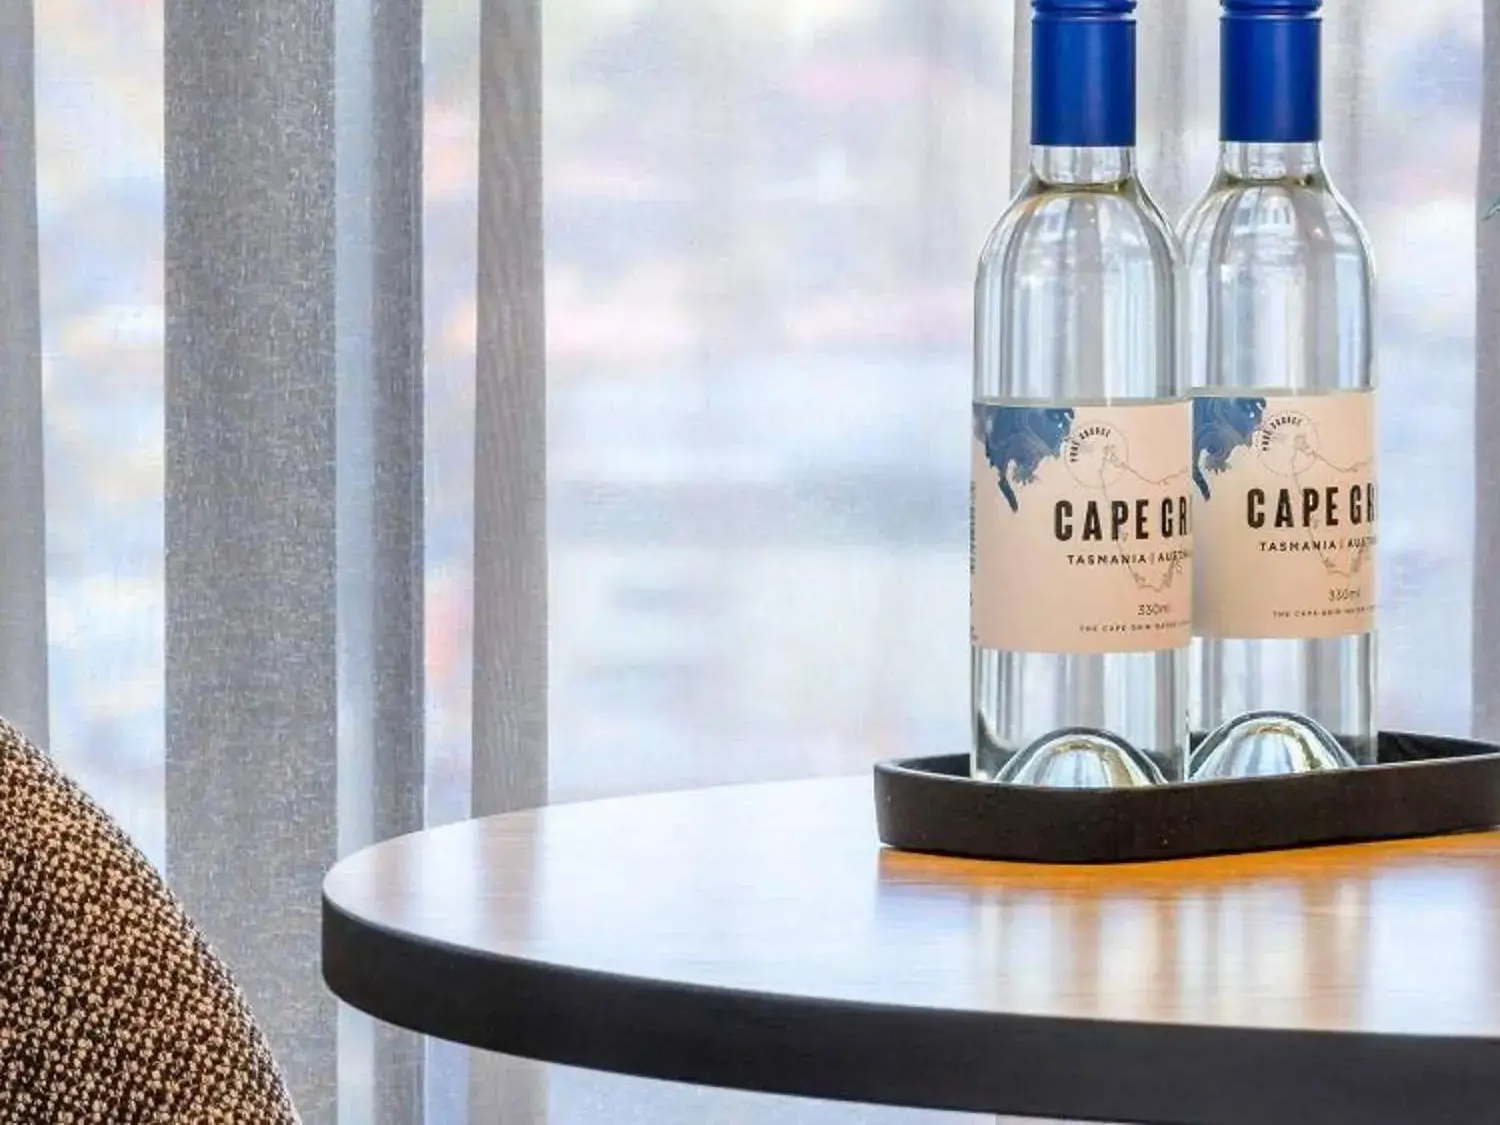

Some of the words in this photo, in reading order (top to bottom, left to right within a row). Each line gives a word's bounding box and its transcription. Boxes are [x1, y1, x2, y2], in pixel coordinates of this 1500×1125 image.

[1054, 499, 1149, 542] CAPE
[1247, 486, 1339, 529] CAPE
[1067, 554, 1147, 566] TASMANIA
[1260, 540, 1337, 553] TASMANIA
